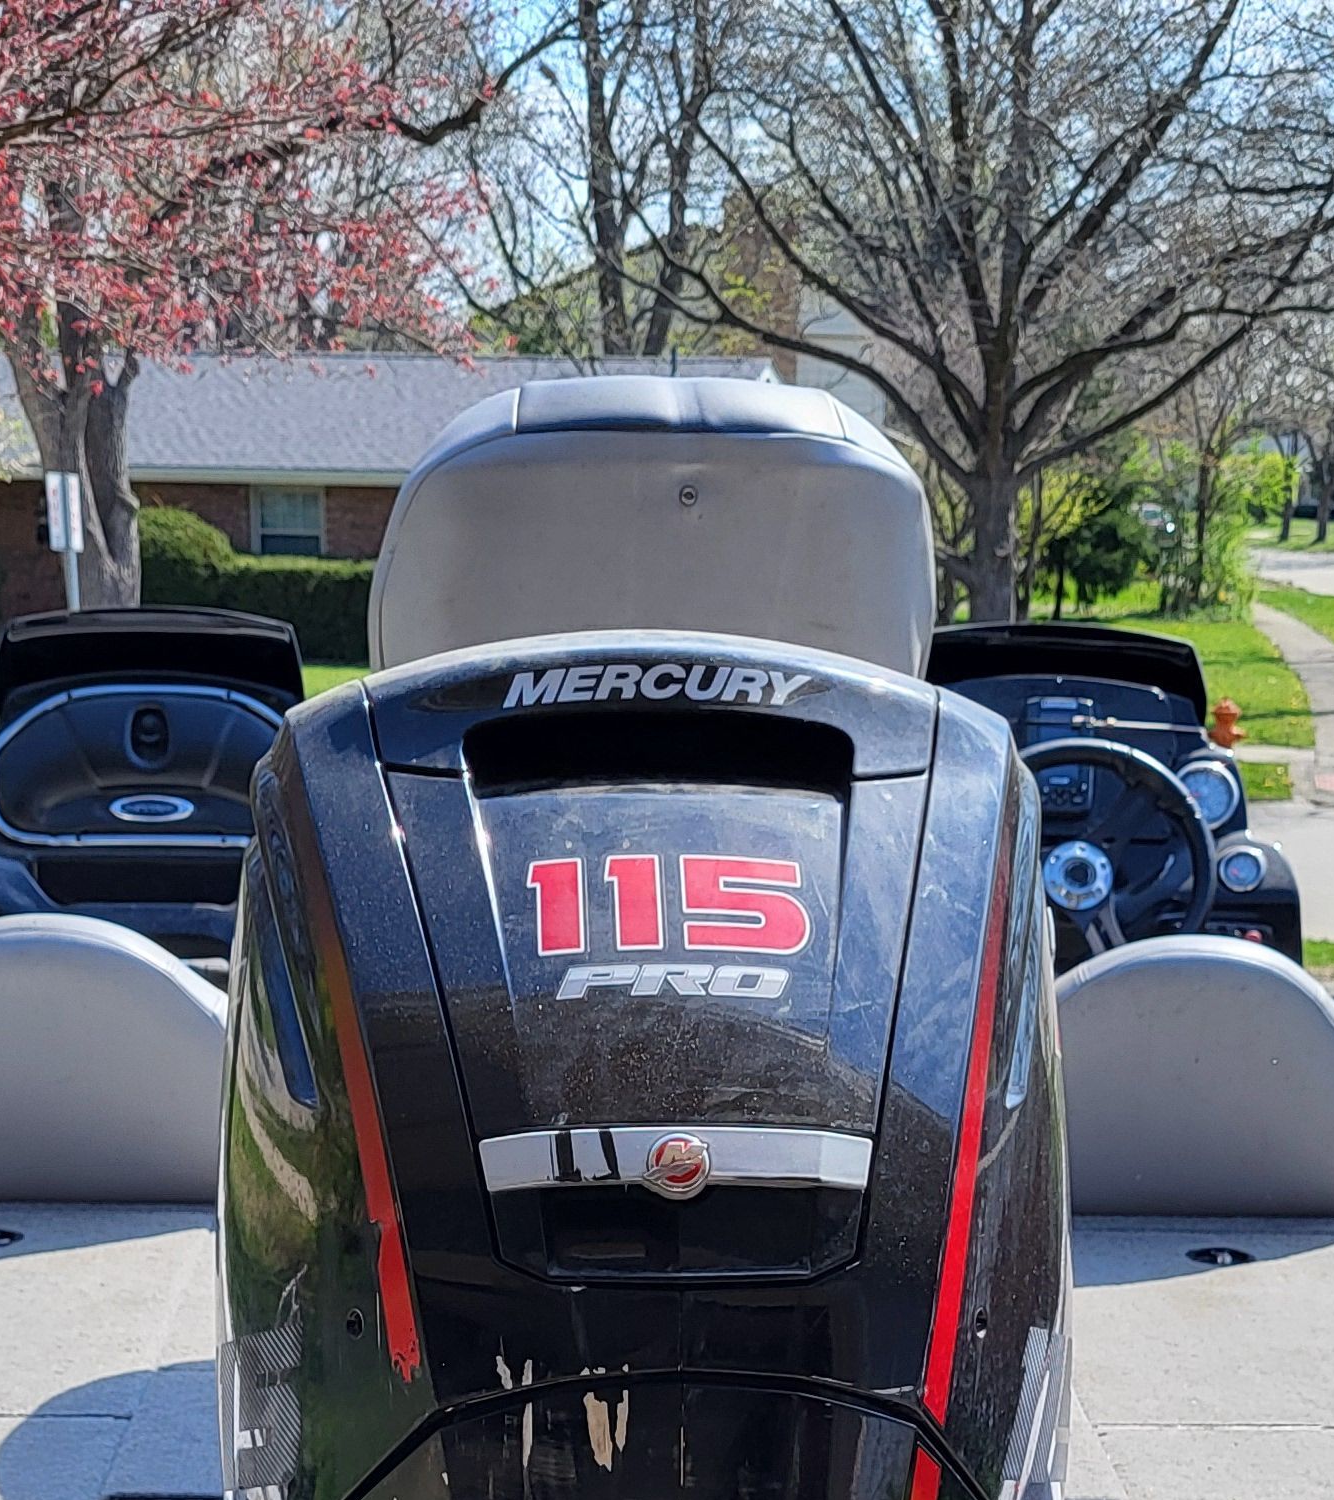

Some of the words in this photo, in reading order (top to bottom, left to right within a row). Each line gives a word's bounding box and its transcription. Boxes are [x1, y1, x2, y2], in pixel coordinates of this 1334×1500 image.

[502, 664, 813, 709] MERCURY
[526, 854, 810, 957] 115
[555, 963, 791, 1000] PRO
